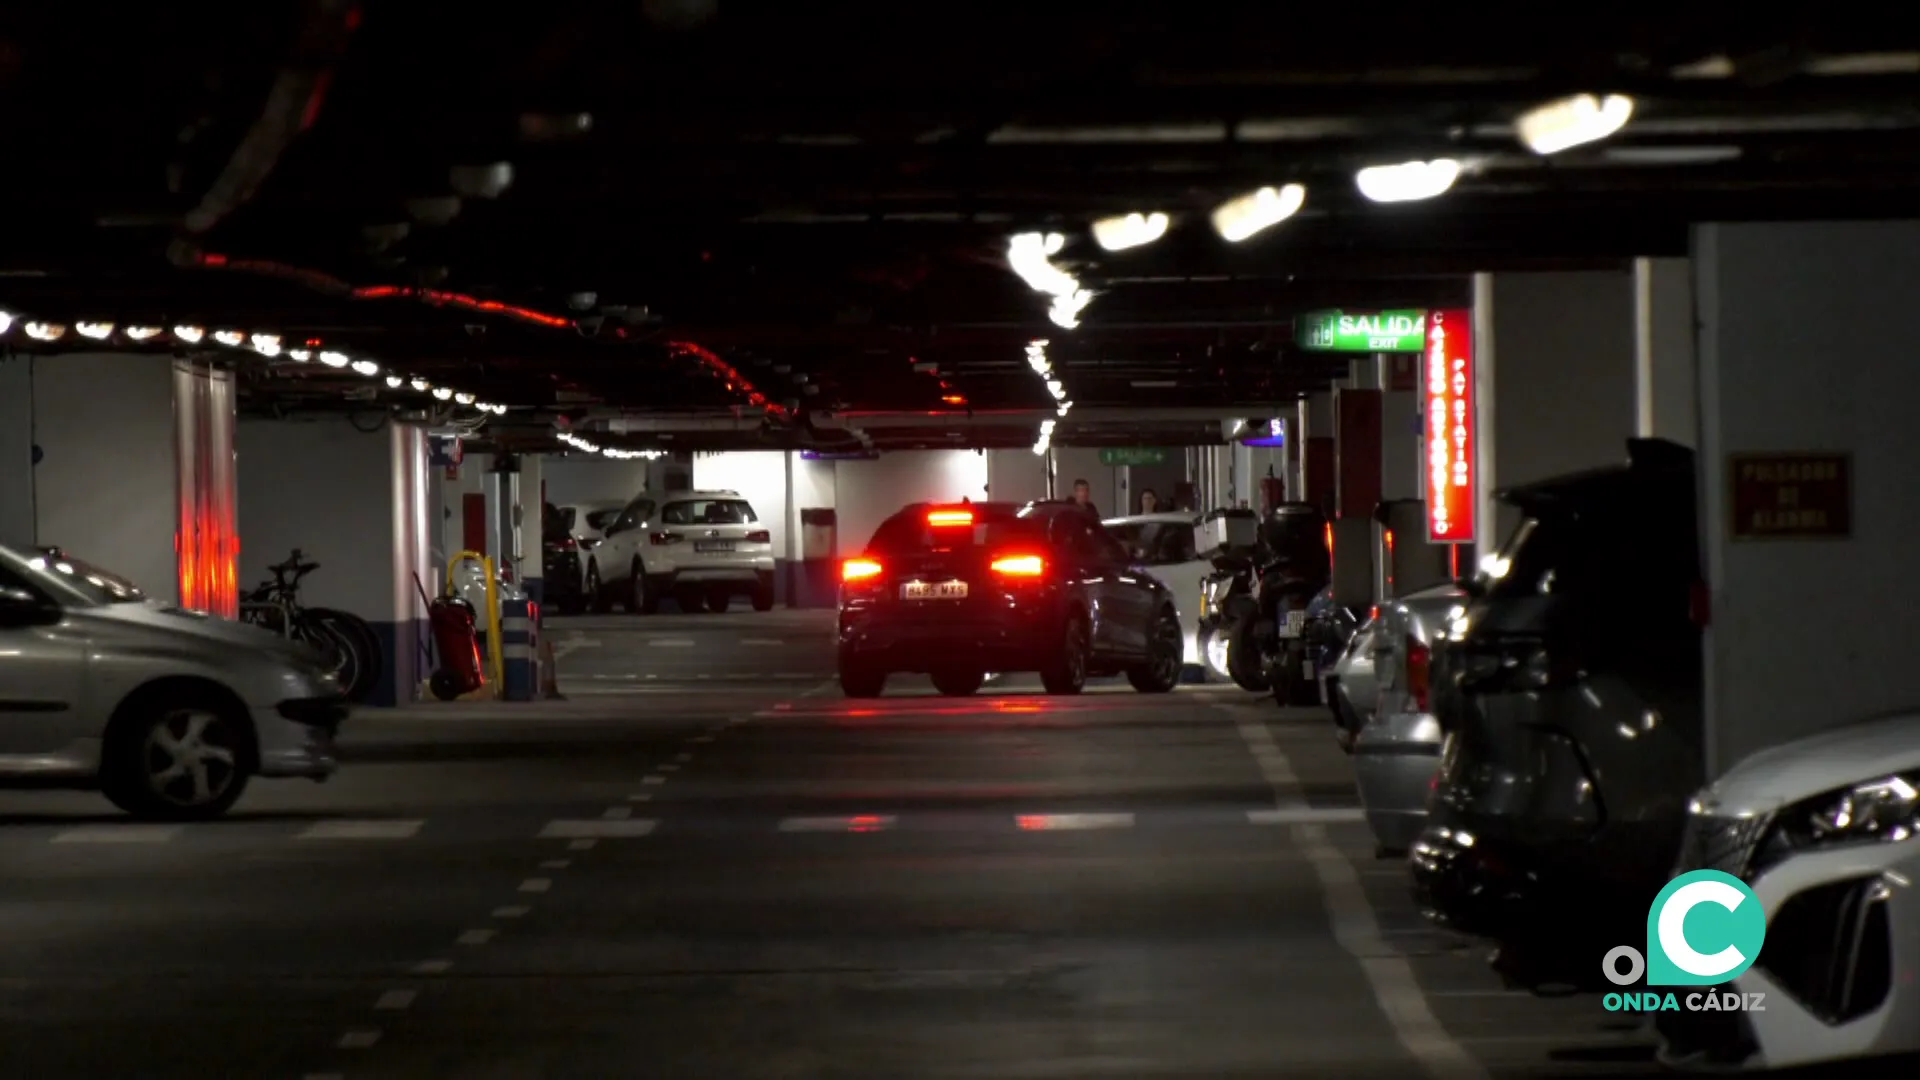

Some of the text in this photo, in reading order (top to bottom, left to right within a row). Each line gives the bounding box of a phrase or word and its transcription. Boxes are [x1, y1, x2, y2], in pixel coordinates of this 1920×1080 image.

[1339, 314, 1425, 336] SALIDA
[1368, 337, 1400, 349] EXIT
[1452, 358, 1466, 397] PAY
